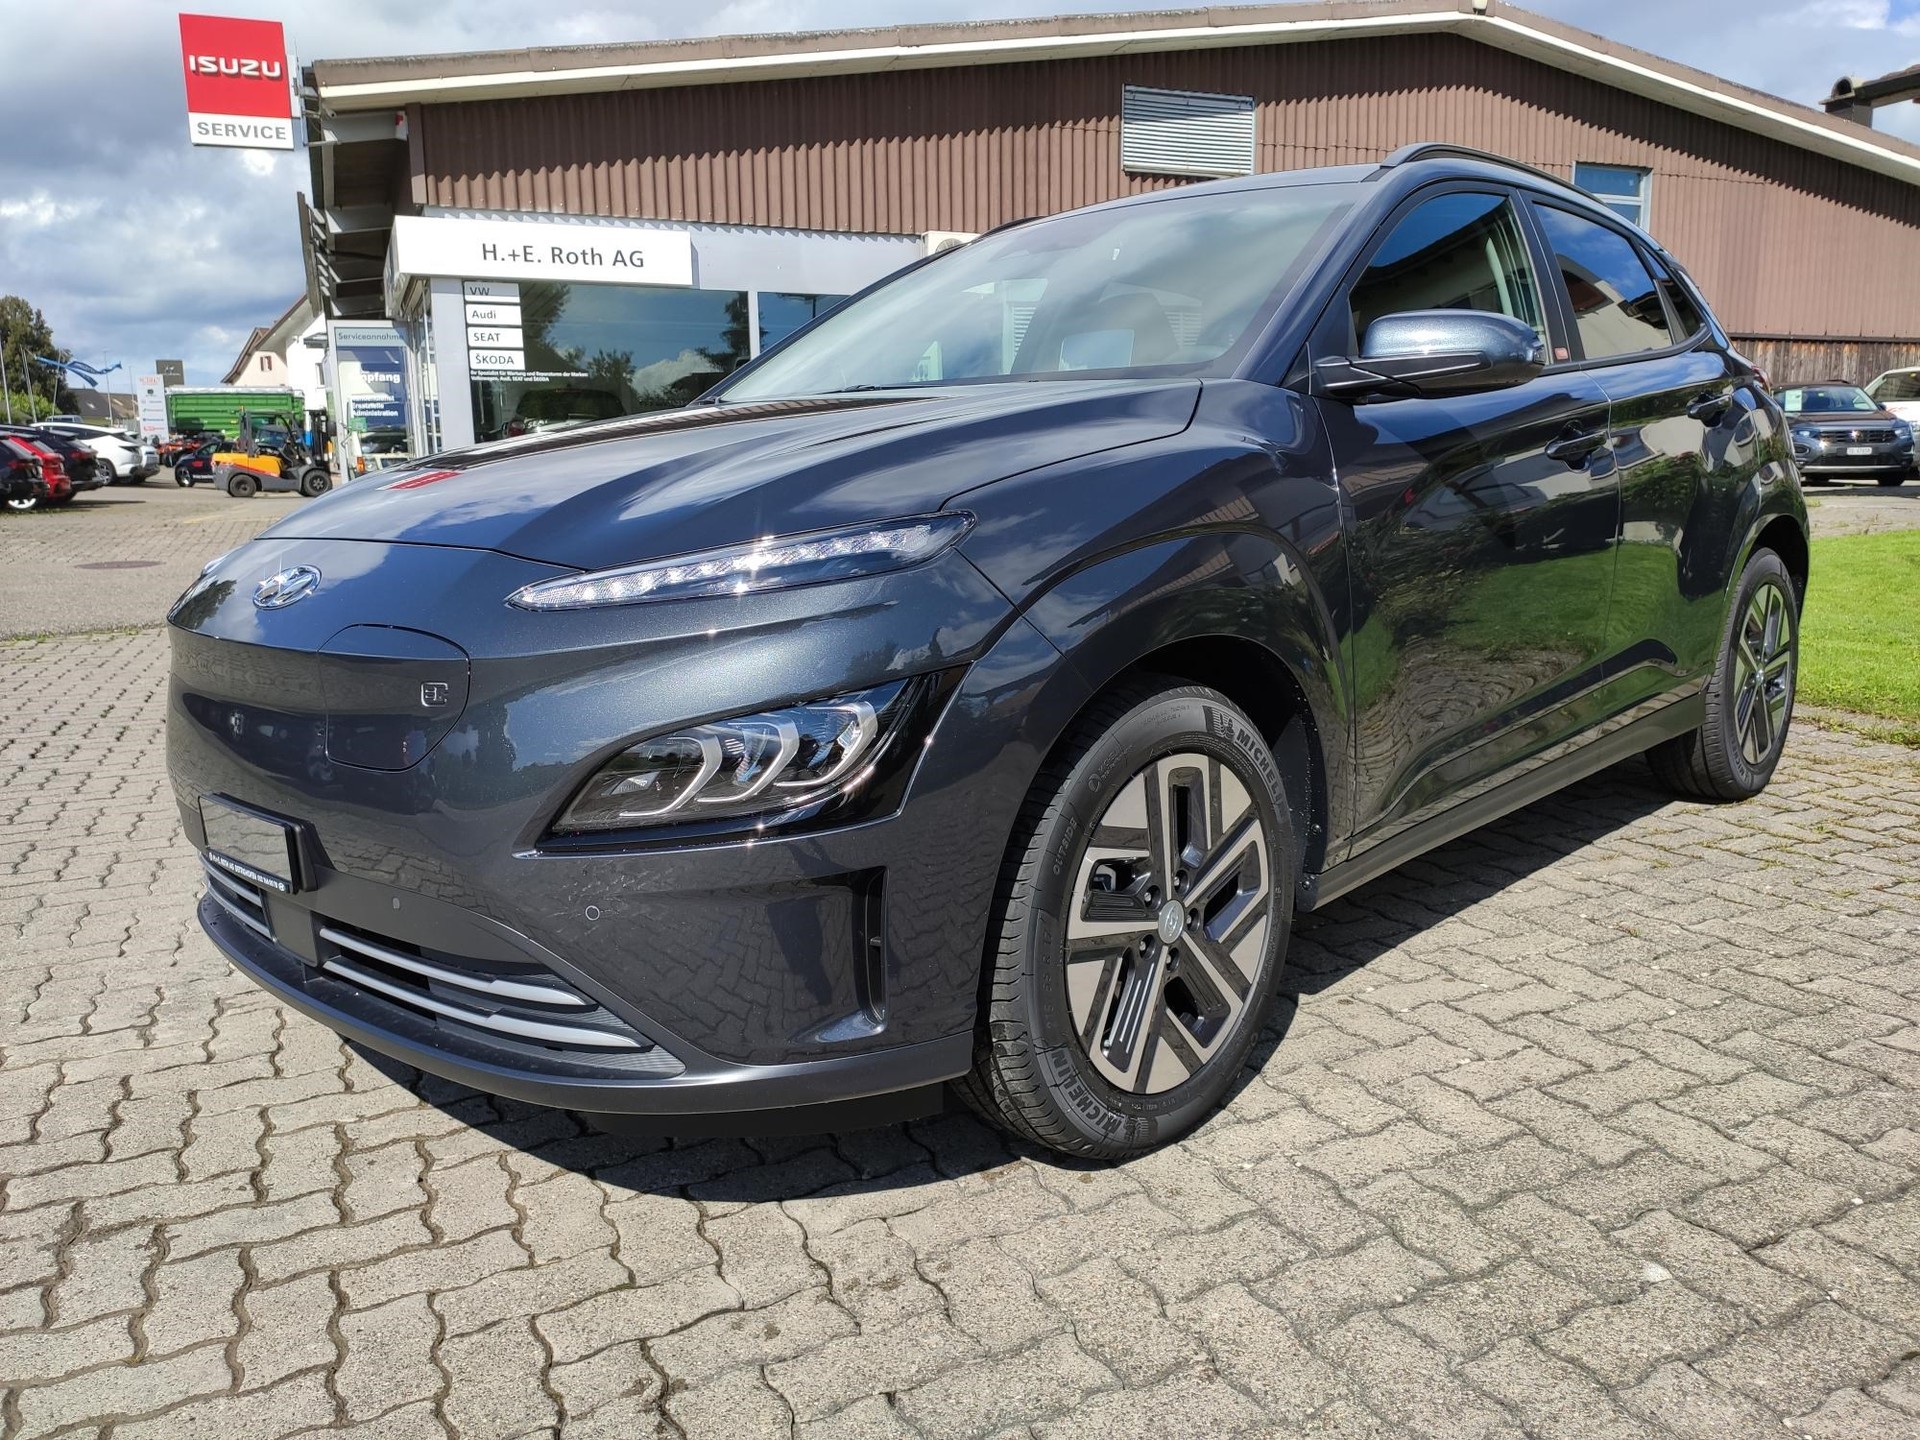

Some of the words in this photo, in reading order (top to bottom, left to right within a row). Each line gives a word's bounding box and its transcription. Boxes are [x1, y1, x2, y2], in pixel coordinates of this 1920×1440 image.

[188, 54, 281, 78] ISUZU
[197, 121, 287, 140] SERVICE
[482, 243, 542, 263] H.+E.
[551, 246, 603, 266] Roth
[612, 249, 644, 268] AG
[469, 286, 490, 296] VW
[471, 310, 497, 319] Audi
[473, 332, 501, 342] SEAT
[475, 353, 515, 365] ŠKODA
[1053, 817, 1078, 876] OUTSIDE
[1051, 1050, 1122, 1135] MICHELIN
